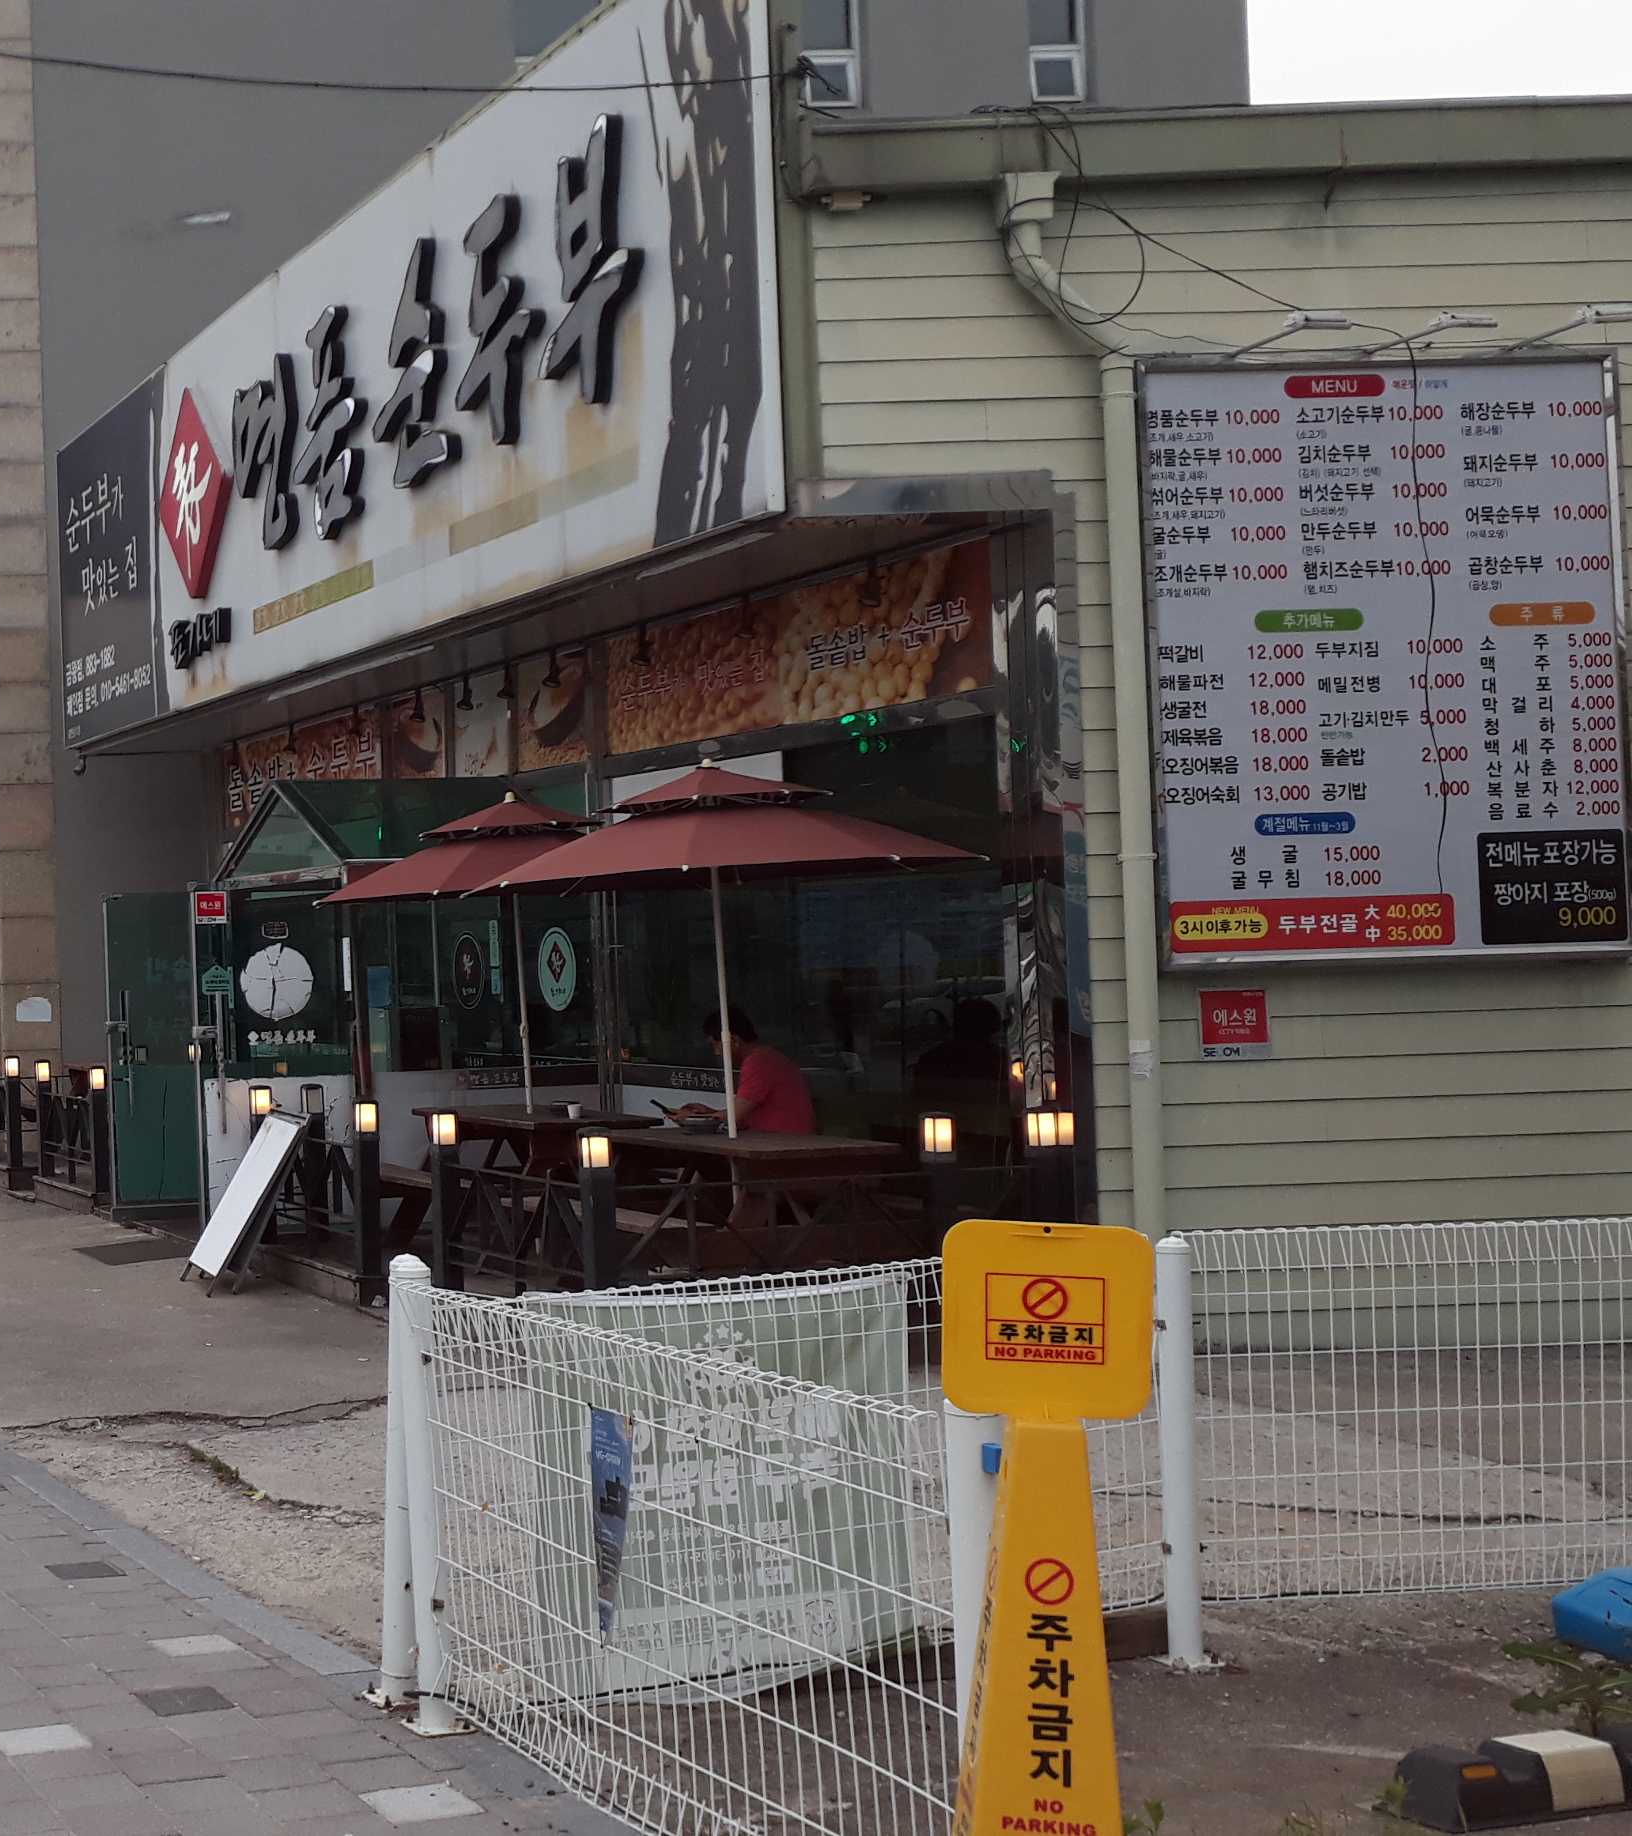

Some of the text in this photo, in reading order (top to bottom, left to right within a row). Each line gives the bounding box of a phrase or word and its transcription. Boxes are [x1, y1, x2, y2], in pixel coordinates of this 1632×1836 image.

[1311, 380, 1358, 393] MENU
[1225, 409, 1280, 426] 10,000
[1296, 405, 1444, 425] 소고기순두부 10,000
[1460, 401, 1603, 421] 해장순두부 10,000
[1150, 448, 1282, 467] 해물순두부 10,000
[1298, 444, 1446, 464] 김치순두부 10,000
[1463, 453, 1605, 473] 돼지순두부 10,000
[1151, 487, 1284, 506] 섞어순두부 10,000
[1299, 483, 1447, 502] 버섯순두부 10,000
[65, 472, 124, 553] 순두부가
[1465, 504, 1608, 525] 어묵순두부 10,000
[1153, 525, 1286, 546] 굴순두부 10,000
[1301, 521, 1449, 541] 만두순두부 10,000
[1154, 564, 1288, 584] 조개순두부 10,000
[1303, 559, 1451, 580] 햄치즈순두부 10,000
[1468, 555, 1610, 576] 곱창순두부 10,000
[81, 536, 138, 617] 맛있는 집
[1282, 613, 1335, 629] 추가메뉴
[806, 597, 970, 671] 돌솥밥 순두부
[1568, 632, 1612, 649] 5,000
[1158, 644, 1304, 663] 떡갈비 12,000
[1315, 638, 1463, 659] 두부지짐 10,000
[85, 644, 116, 677] 883-1882
[1569, 653, 1613, 670] 5,000
[1159, 672, 1305, 691] 해물파전 12,000
[1318, 673, 1465, 693] 메밀전병 10,000
[1570, 674, 1614, 691] 5,000
[1161, 699, 1306, 719] 생굴전 18,000
[1571, 695, 1615, 712] 4,000
[1420, 709, 1467, 726] 5,000
[1572, 716, 1616, 733] 5,000
[1163, 727, 1308, 747] 제육볶음 18,000
[1573, 737, 1617, 754] 8,000
[1164, 756, 1309, 775] 오징어볶음 18,000
[1320, 746, 1468, 766] 돌솥밥 2,000
[1574, 758, 1618, 775] 8,000
[1165, 785, 1310, 805] 오징어숙회 13,000
[1322, 780, 1470, 801] 공기밥 1,000
[1567, 779, 1619, 796] 12,000
[1576, 801, 1620, 817] 2,000
[1262, 816, 1311, 834] 계절메뉴
[1324, 846, 1380, 863] 15,000
[1325, 869, 1381, 887] 18,000
[1494, 882, 1547, 906] 짱아지
[199, 900, 221, 910] 에스원
[1278, 903, 1442, 935] 두부전골 大 40,000
[1558, 906, 1616, 929] 9,000
[1365, 925, 1442, 943] 中 35,000
[1213, 1008, 1257, 1026] 에스원
[999, 1323, 1094, 1345] 주차금지
[995, 1346, 1096, 1361] NO PARKING
[1026, 1613, 1074, 1788] 주차금지
[1033, 1798, 1064, 1814] NO
[1001, 1816, 1097, 1836] PARKING
